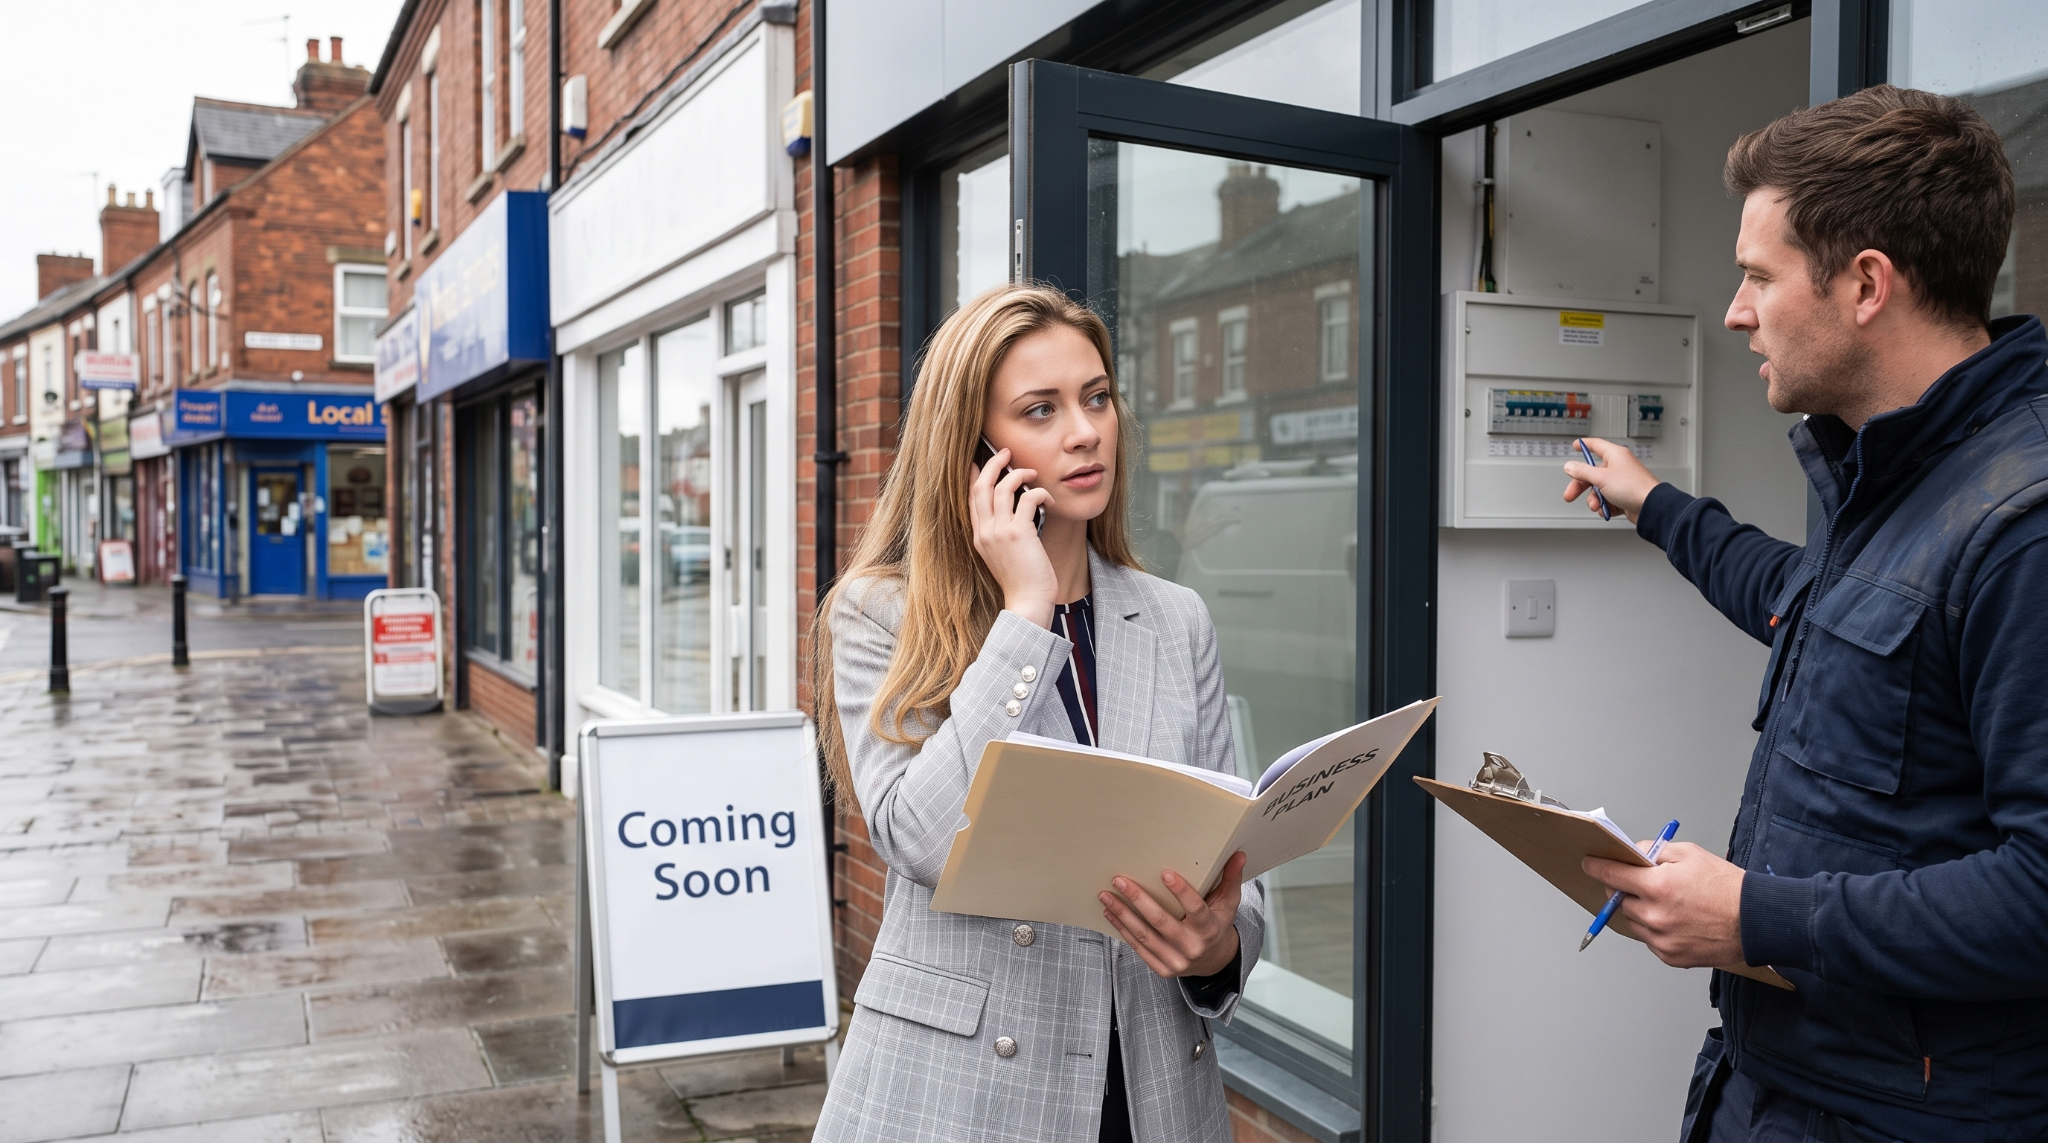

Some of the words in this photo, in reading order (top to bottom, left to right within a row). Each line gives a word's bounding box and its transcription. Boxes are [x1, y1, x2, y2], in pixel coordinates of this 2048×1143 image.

[308, 400, 374, 425] Local
[1263, 748, 1379, 816] BUSINESS
[1271, 781, 1335, 821] PLAN
[618, 804, 796, 849] Coming
[654, 862, 770, 900] Soon
